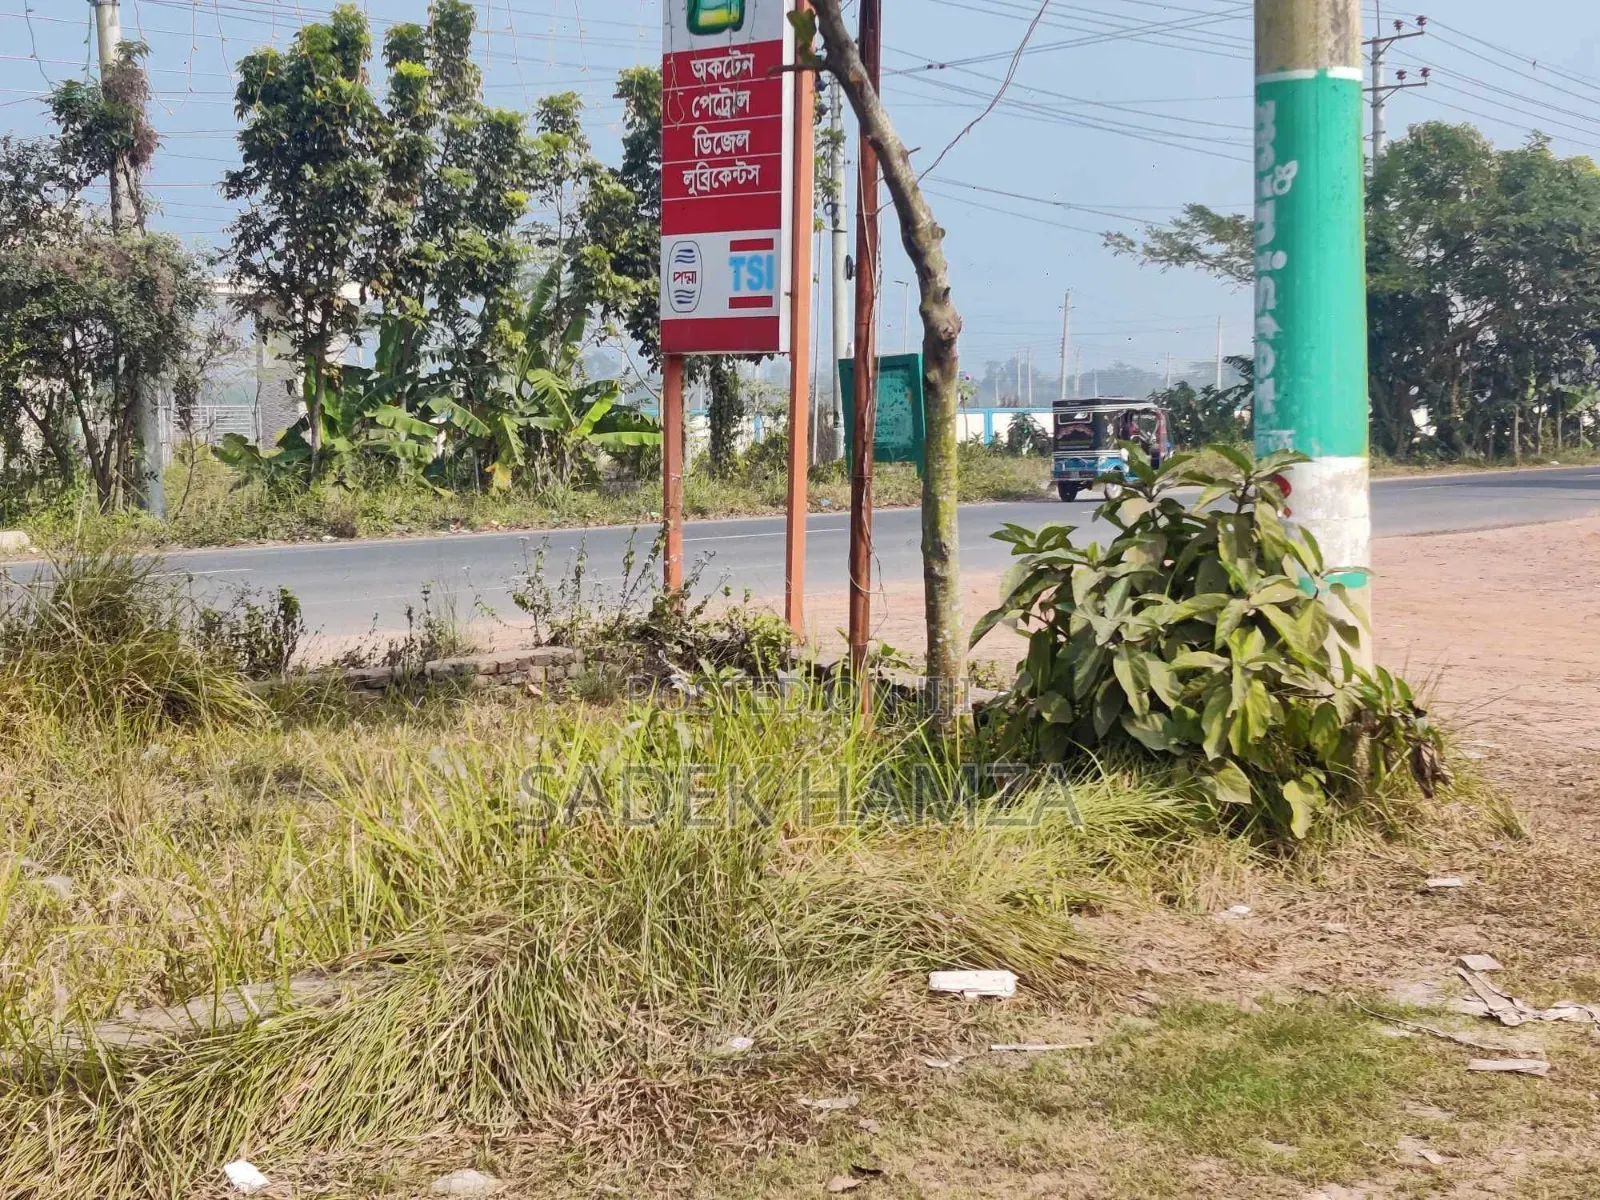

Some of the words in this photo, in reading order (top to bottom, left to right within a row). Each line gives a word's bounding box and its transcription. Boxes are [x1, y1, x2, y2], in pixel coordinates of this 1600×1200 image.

[690, 49, 755, 82] অকটেন
[692, 86, 750, 118] পেট্রোল
[693, 126, 750, 157] ডিজেল
[682, 160, 760, 196] লুব্রিকেন্টস
[673, 270, 697, 285] পদ্মা
[729, 254, 775, 292] TSI
